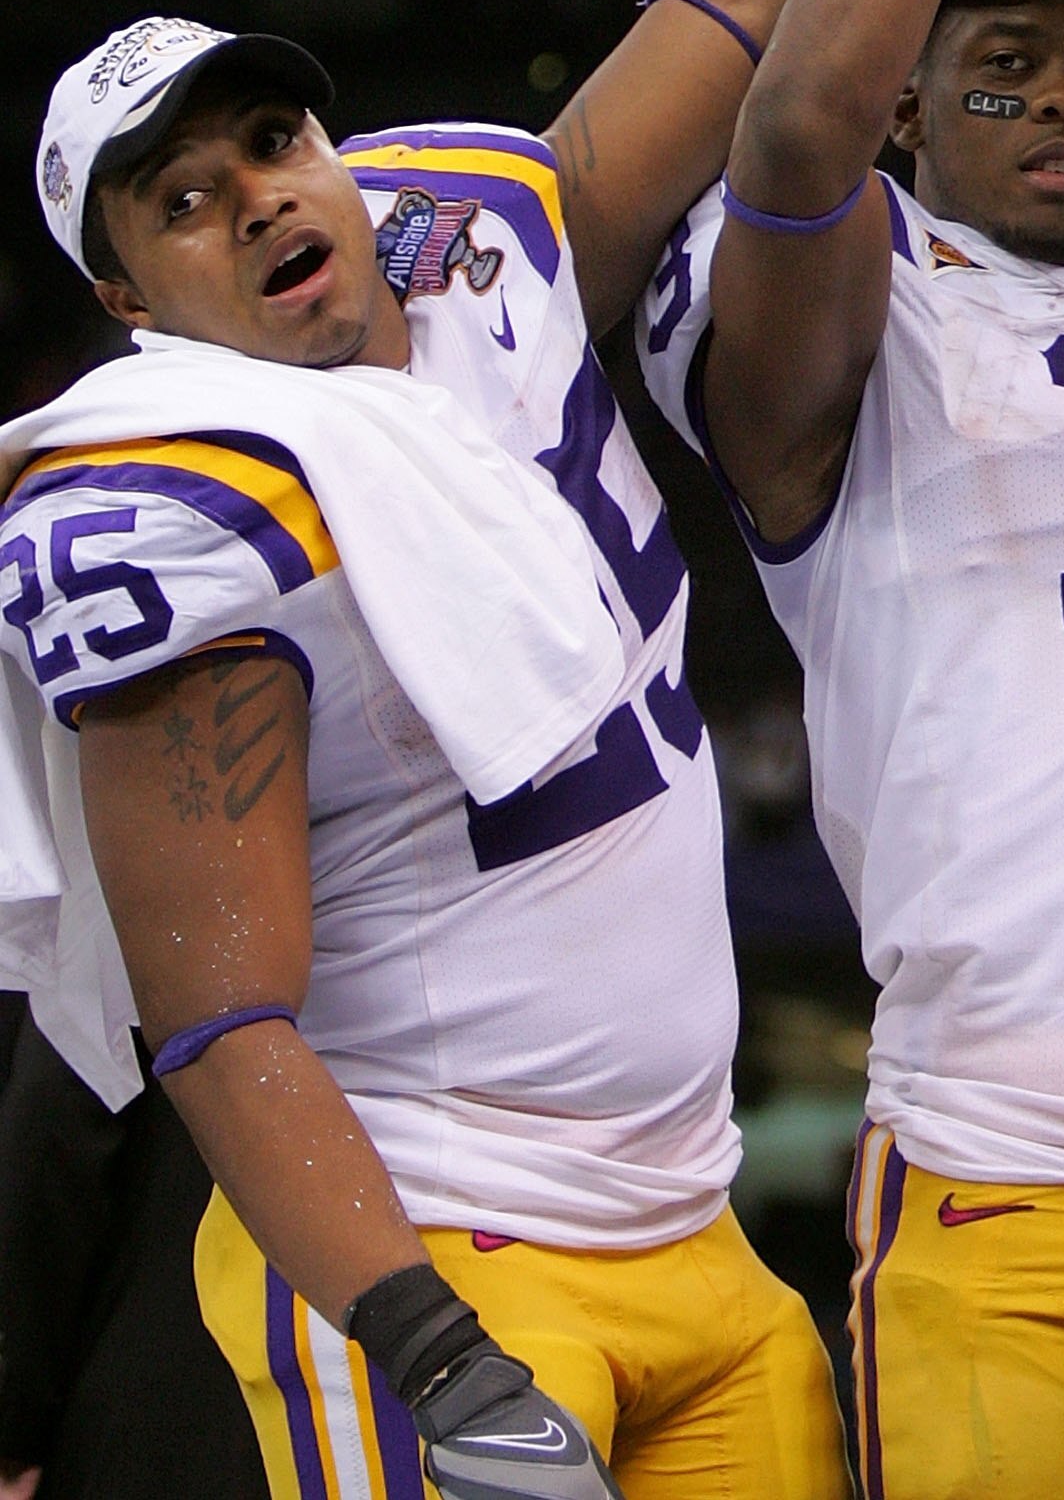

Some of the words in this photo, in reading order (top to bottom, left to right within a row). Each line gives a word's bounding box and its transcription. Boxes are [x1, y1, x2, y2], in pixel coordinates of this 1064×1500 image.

[153, 33, 199, 52] LSU
[386, 214, 431, 290] Allstate
[0, 507, 175, 685] 25
